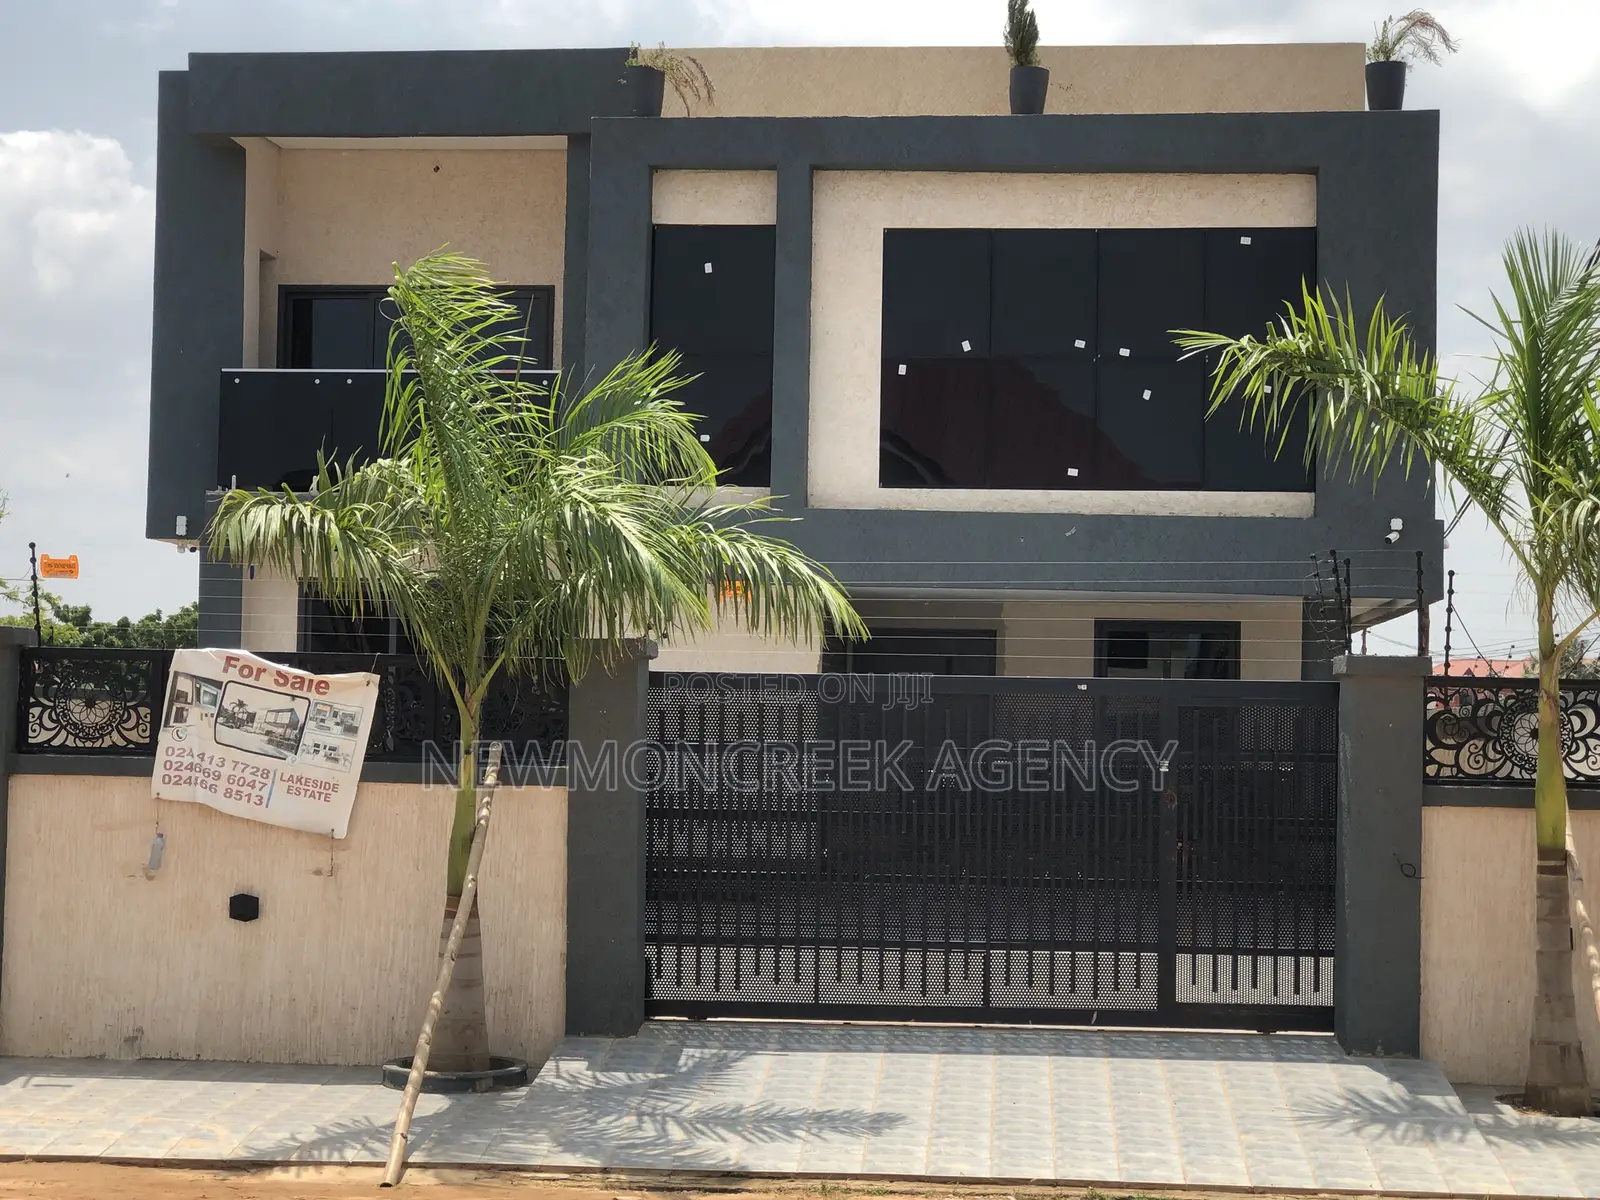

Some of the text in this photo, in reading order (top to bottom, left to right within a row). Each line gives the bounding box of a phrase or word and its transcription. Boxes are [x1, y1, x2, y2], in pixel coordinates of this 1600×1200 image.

[222, 655, 267, 681] For
[231, 760, 271, 780] 7728
[227, 774, 268, 792] 6047
[279, 772, 340, 793] LAKESIDE
[223, 787, 264, 806] 8513
[286, 785, 332, 803] ESTATE
